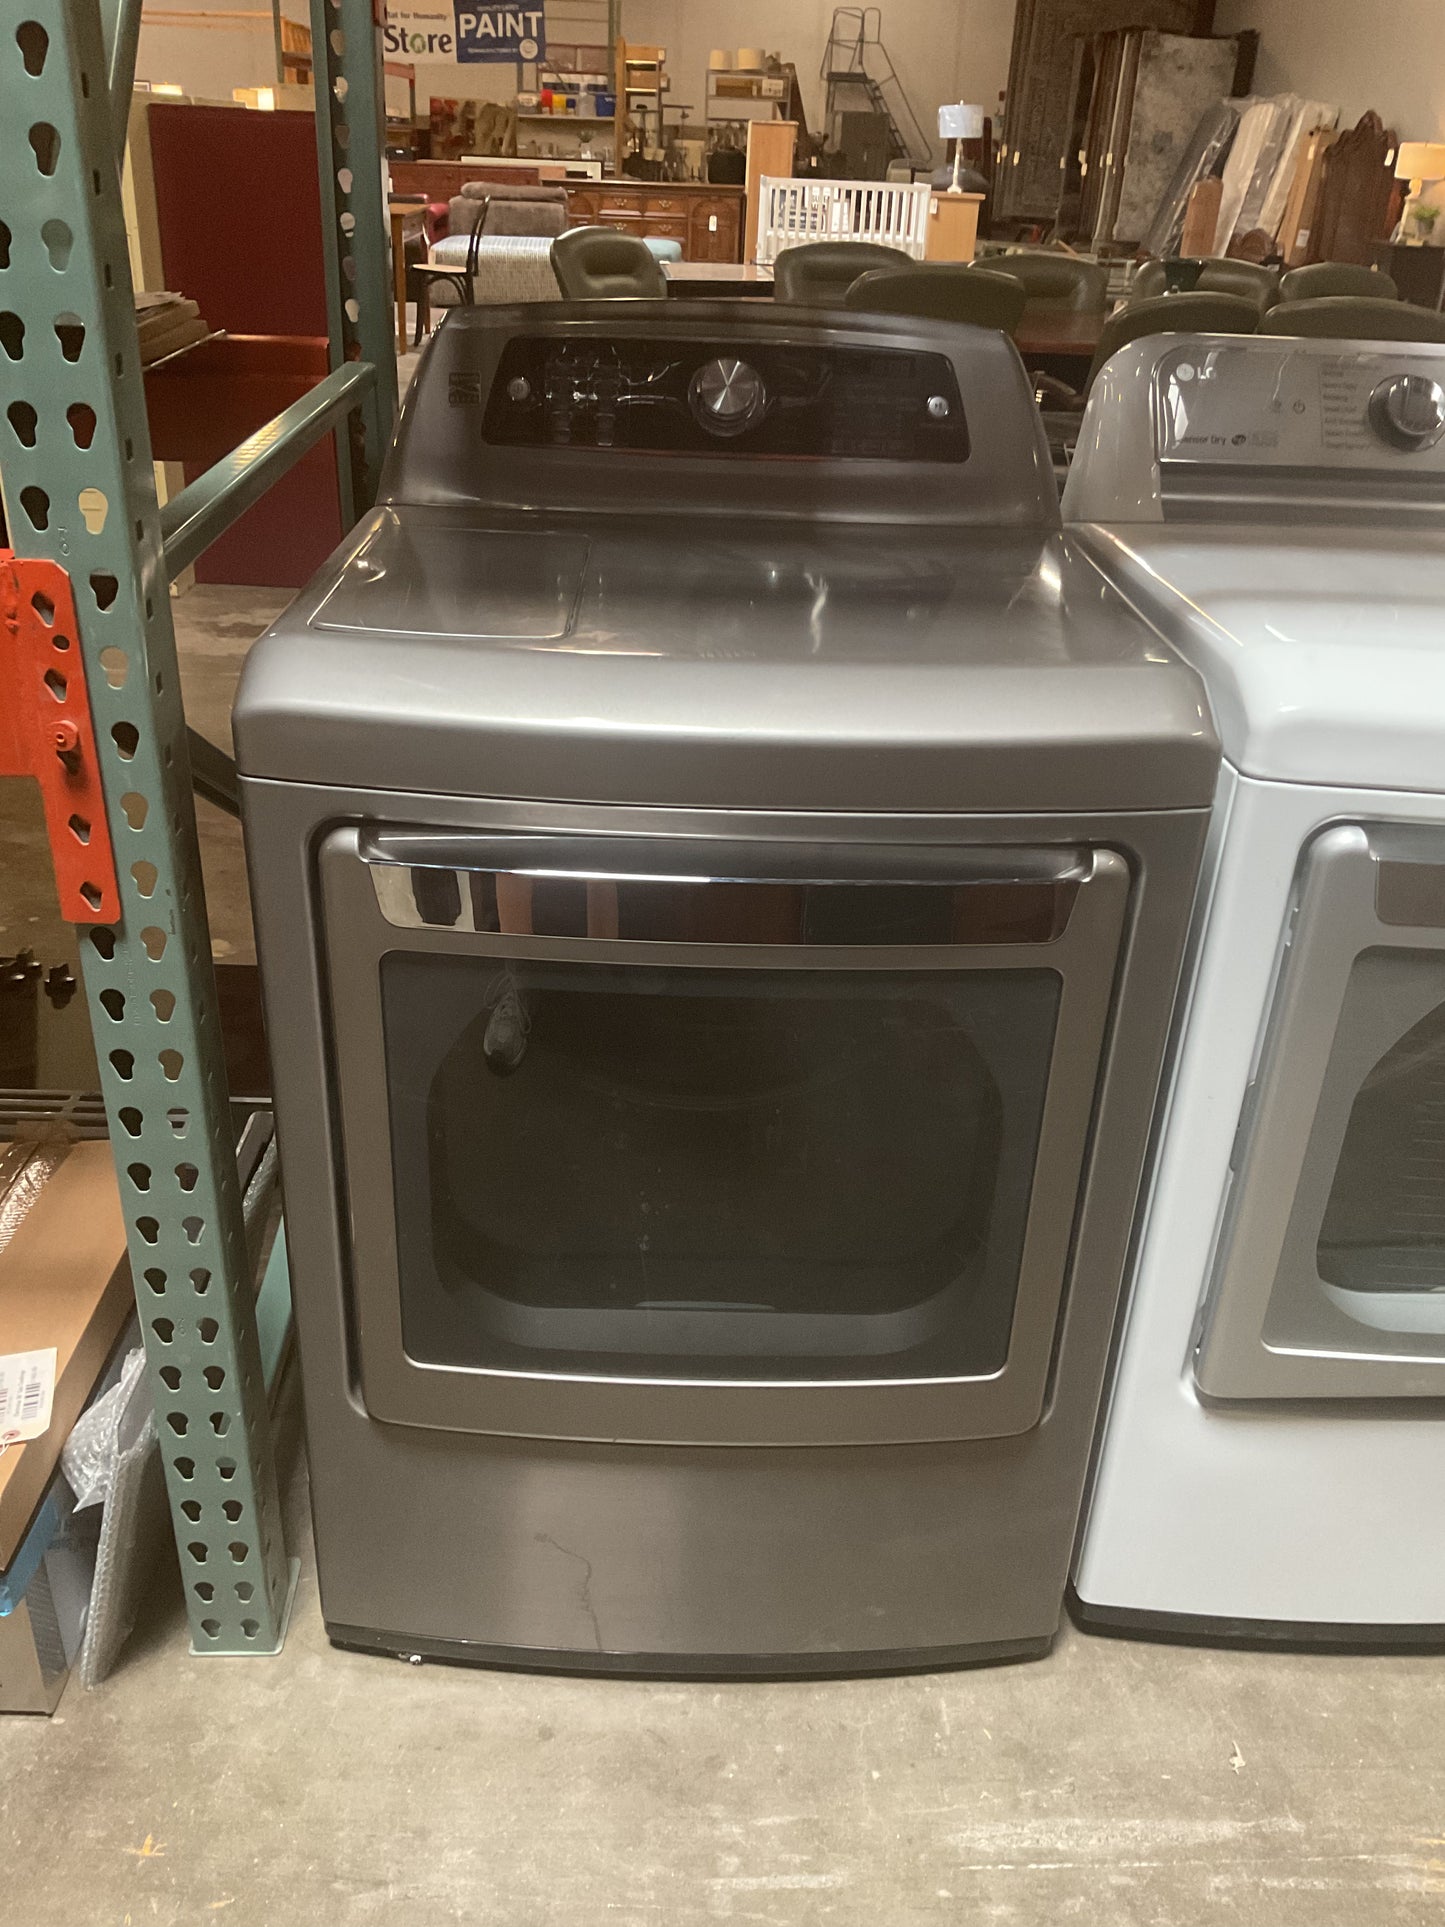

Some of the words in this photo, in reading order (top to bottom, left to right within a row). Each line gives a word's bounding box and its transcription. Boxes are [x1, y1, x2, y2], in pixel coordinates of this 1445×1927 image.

[413, 12, 447, 21] Humanity
[459, 11, 543, 39] PAINT
[384, 25, 453, 54] Store
